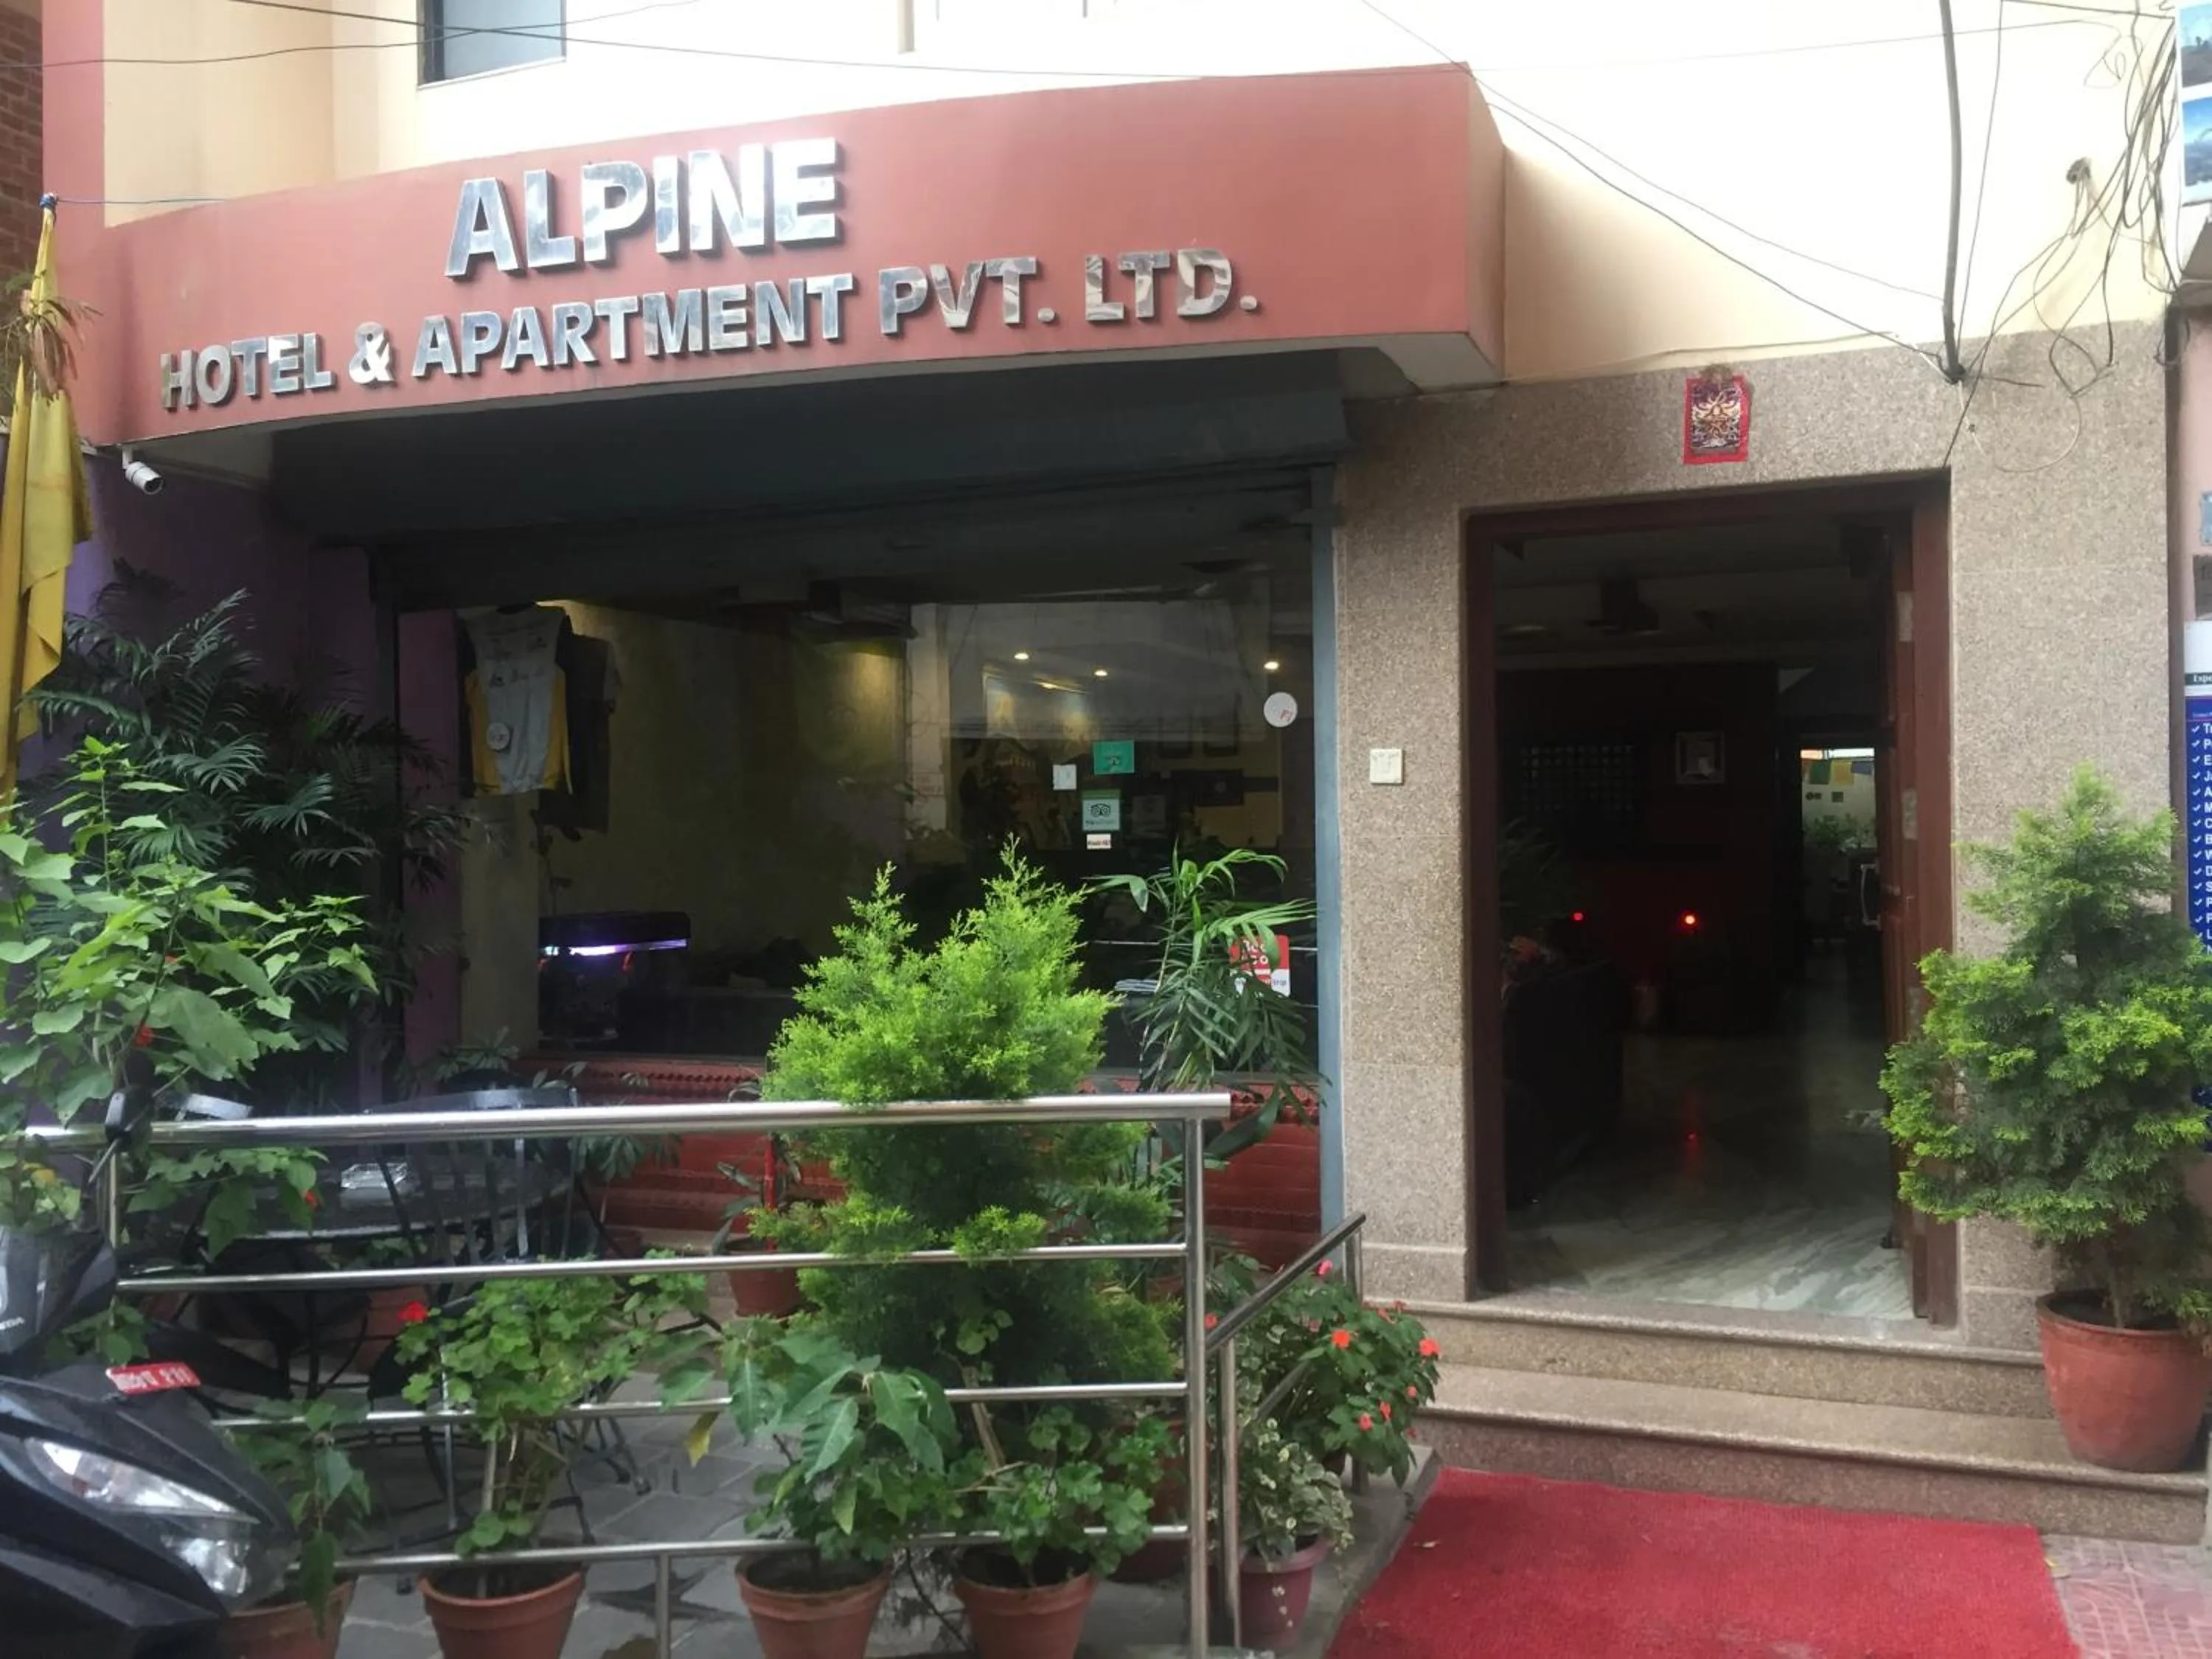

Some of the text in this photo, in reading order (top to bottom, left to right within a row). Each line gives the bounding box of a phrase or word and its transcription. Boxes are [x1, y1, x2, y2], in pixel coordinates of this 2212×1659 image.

[443, 136, 842, 280] ALPINE
[159, 248, 1258, 411] HOTEL & APARTMENT PVT. LTD.
